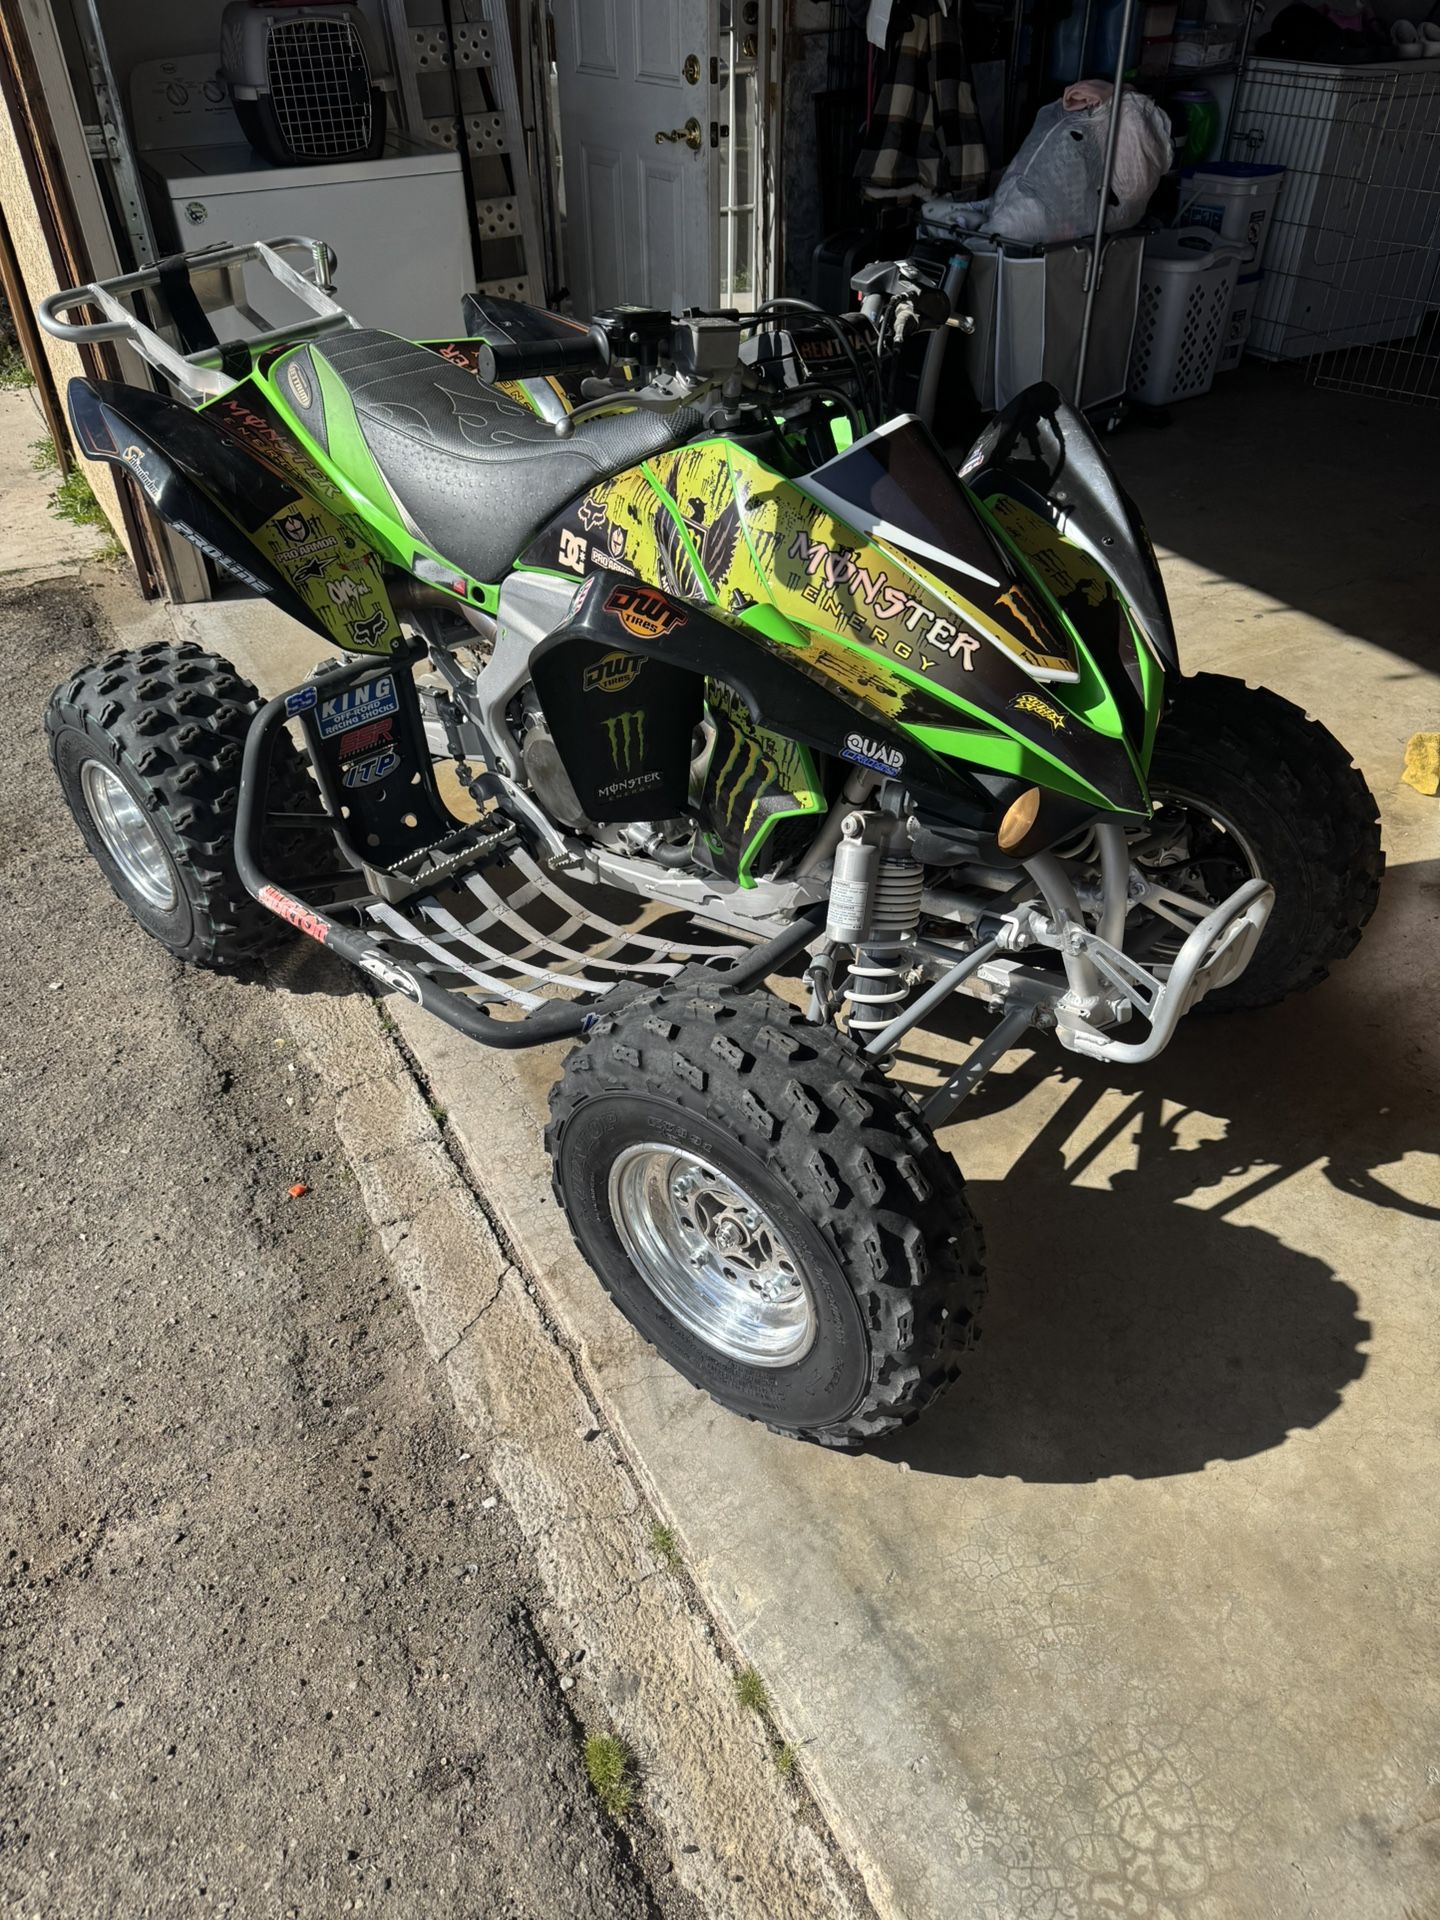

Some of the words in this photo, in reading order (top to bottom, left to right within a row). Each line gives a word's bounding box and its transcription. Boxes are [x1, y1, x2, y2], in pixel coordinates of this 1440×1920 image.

[275, 547, 299, 563] PRO
[299, 536, 338, 558] ARMOR
[558, 528, 588, 575] DC
[592, 549, 609, 567] PRO
[606, 588, 686, 628] DWT
[788, 530, 982, 672] MONSTER
[801, 584, 938, 671] ENERGY
[585, 654, 646, 686] DWT
[322, 678, 391, 719] KING
[334, 701, 381, 723] OFF-ROAD
[325, 714, 359, 735] RACING
[361, 702, 394, 721] SHOCKS
[847, 733, 904, 768] QUAD
[346, 752, 396, 787] ITP
[598, 771, 661, 797] MONSTER
